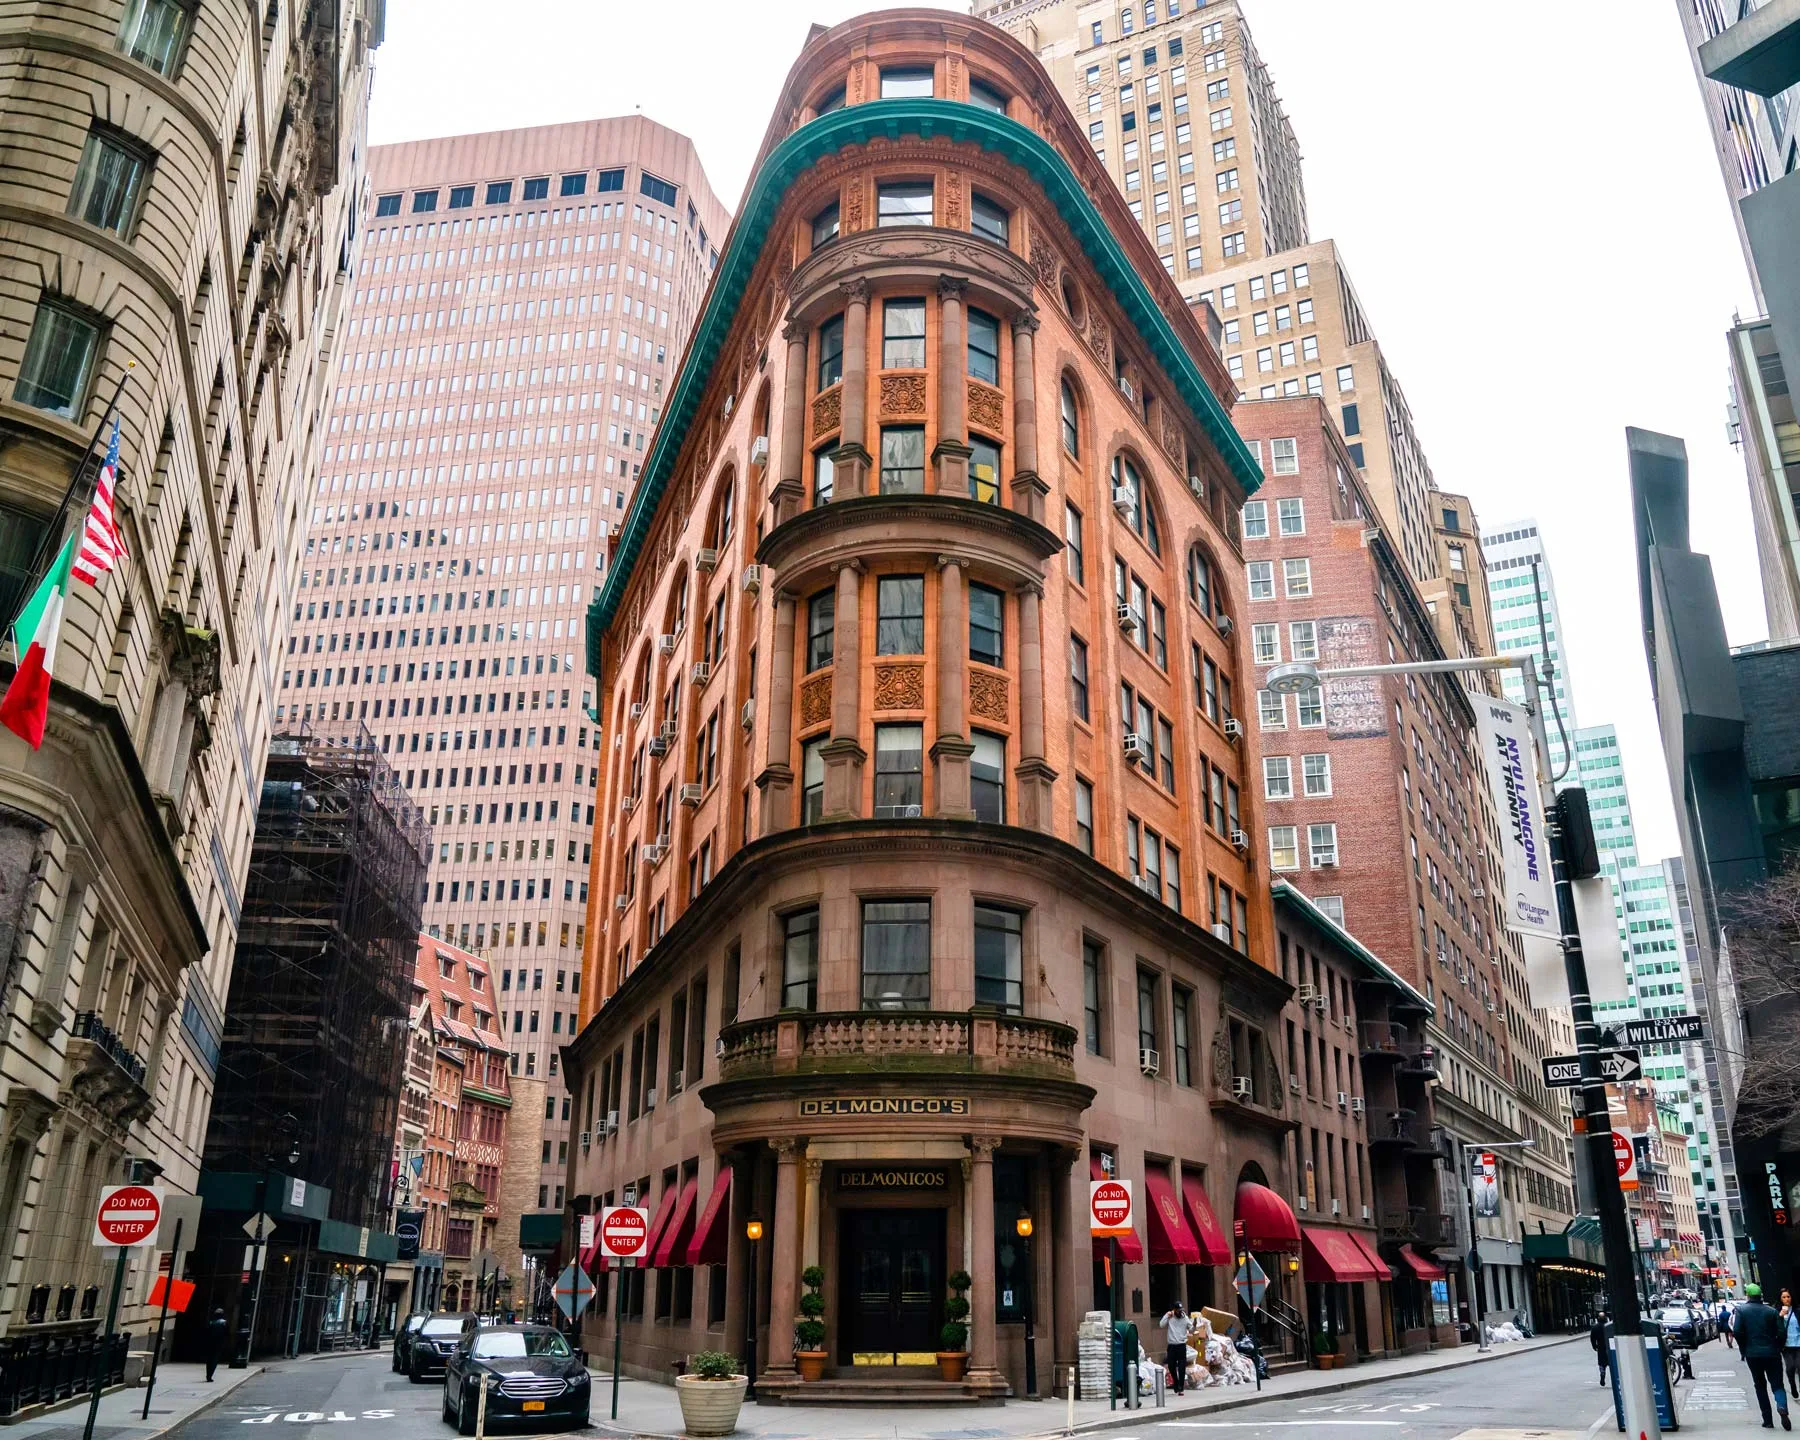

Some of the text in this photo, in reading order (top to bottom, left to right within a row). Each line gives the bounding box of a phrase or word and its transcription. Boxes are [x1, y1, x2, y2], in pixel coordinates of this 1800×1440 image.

[1489, 706, 1513, 723] NYC
[1494, 732, 1524, 847] AT TRINITY
[1506, 736, 1540, 882] NYU LANGONE
[1517, 900, 1550, 916] NYU Langone
[1526, 913, 1544, 925] Health
[1629, 1022, 1700, 1042] WILLIAM ST
[1551, 1064, 1581, 1078] ONE
[804, 1100, 964, 1115] DELMONICO'S
[1612, 1138, 1623, 1147] OT
[841, 1172, 945, 1186] DELMONICOS
[1765, 1162, 1785, 1209] PARK
[1098, 1190, 1124, 1199] DO NOT
[111, 1198, 151, 1208] DO NOT
[609, 1217, 640, 1225] DO NOT
[1098, 1210, 1124, 1218] ENTER
[109, 1224, 144, 1233] ENTER
[612, 1238, 637, 1247] ENTER
[240, 1409, 396, 1424] STOP
